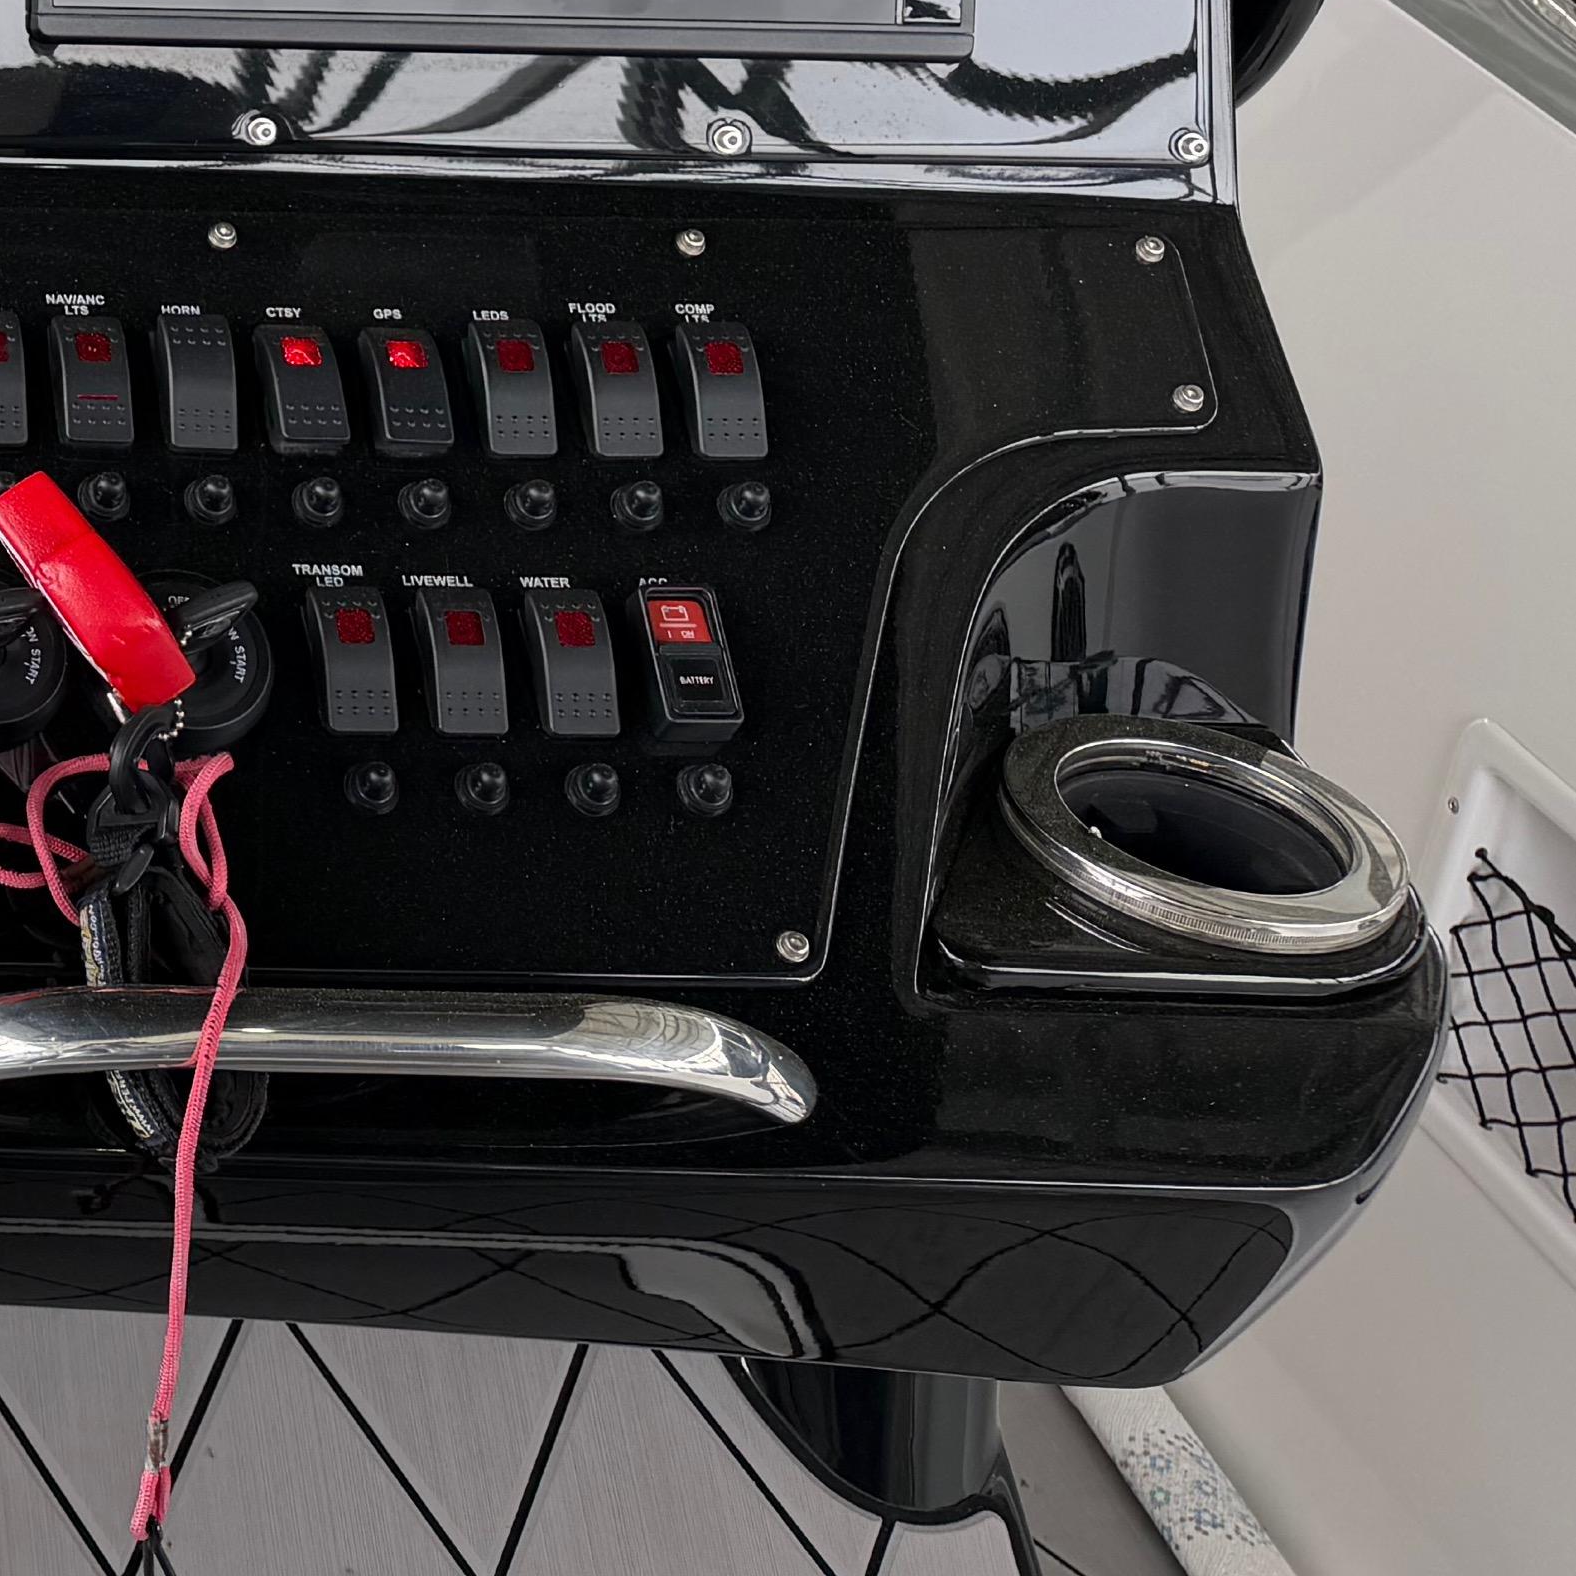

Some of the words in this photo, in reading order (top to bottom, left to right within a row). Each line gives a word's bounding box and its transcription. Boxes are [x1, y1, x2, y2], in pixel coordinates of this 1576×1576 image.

[64, 305, 89, 316] LTS
[161, 305, 201, 315] HORN
[266, 307, 301, 318] CTSY
[373, 309, 401, 319] GPS
[568, 303, 616, 314] FLOOD
[675, 304, 715, 314] COMP
[473, 311, 509, 320] LEDS
[292, 563, 364, 577] TRANSOM
[316, 577, 345, 588] LED
[402, 575, 473, 587] LIVEWELL
[520, 577, 570, 588] WATER
[234, 645, 247, 683] START
[679, 676, 714, 685] BATTERY
